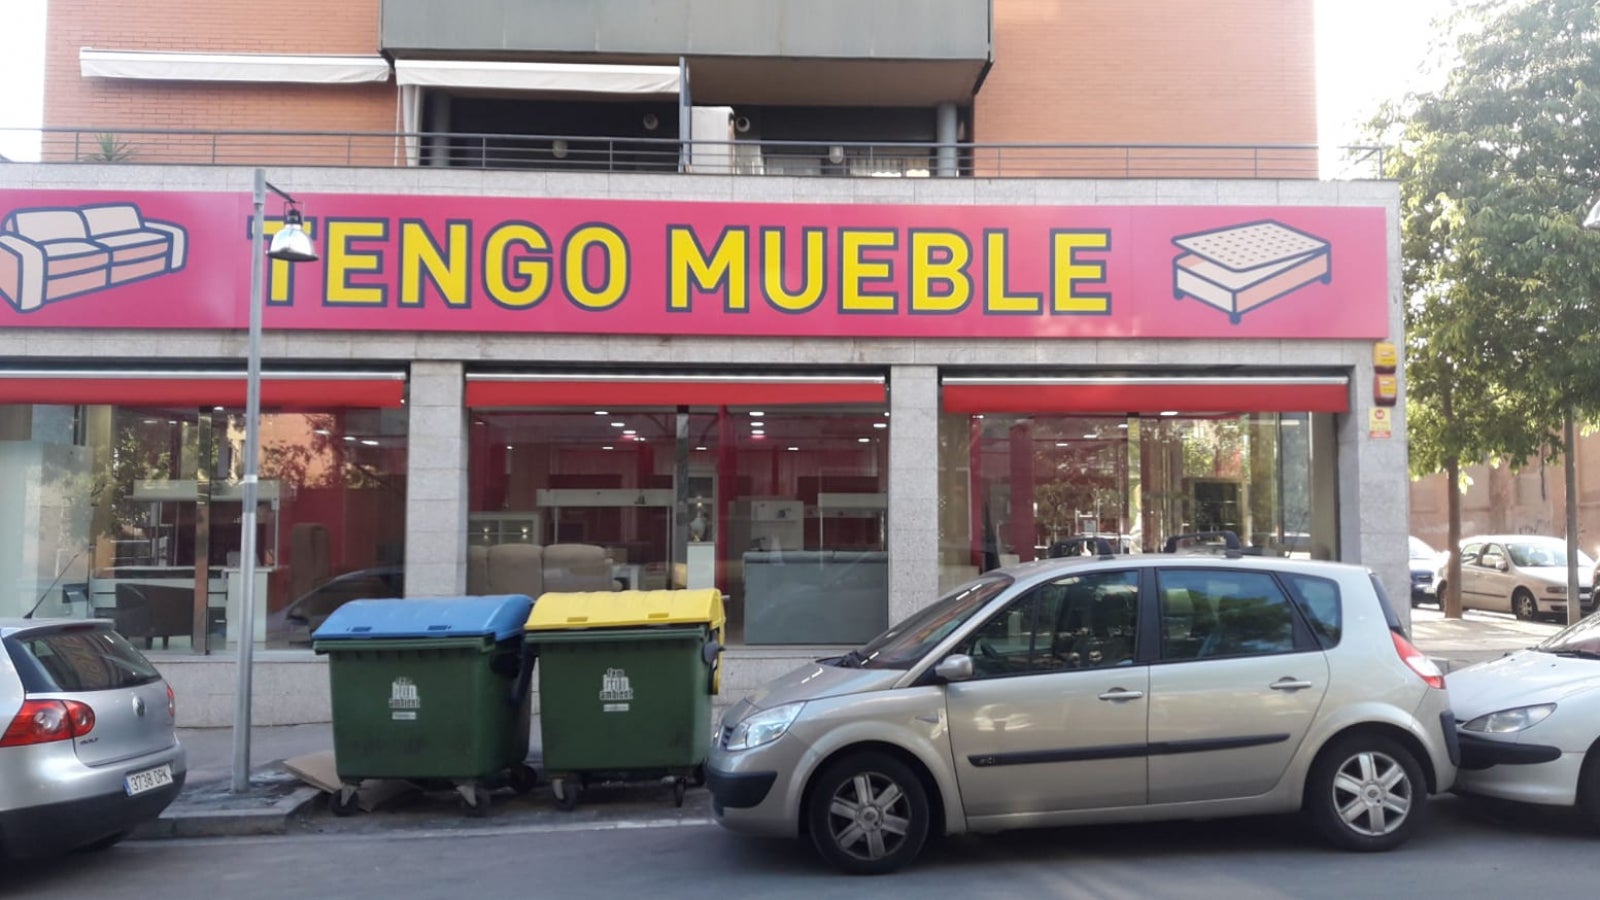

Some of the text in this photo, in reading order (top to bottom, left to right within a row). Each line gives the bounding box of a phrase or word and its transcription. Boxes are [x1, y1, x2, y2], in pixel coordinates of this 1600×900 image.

[247, 215, 1113, 316] TENGO MUEBLE
[130, 772, 154, 791] 3738
